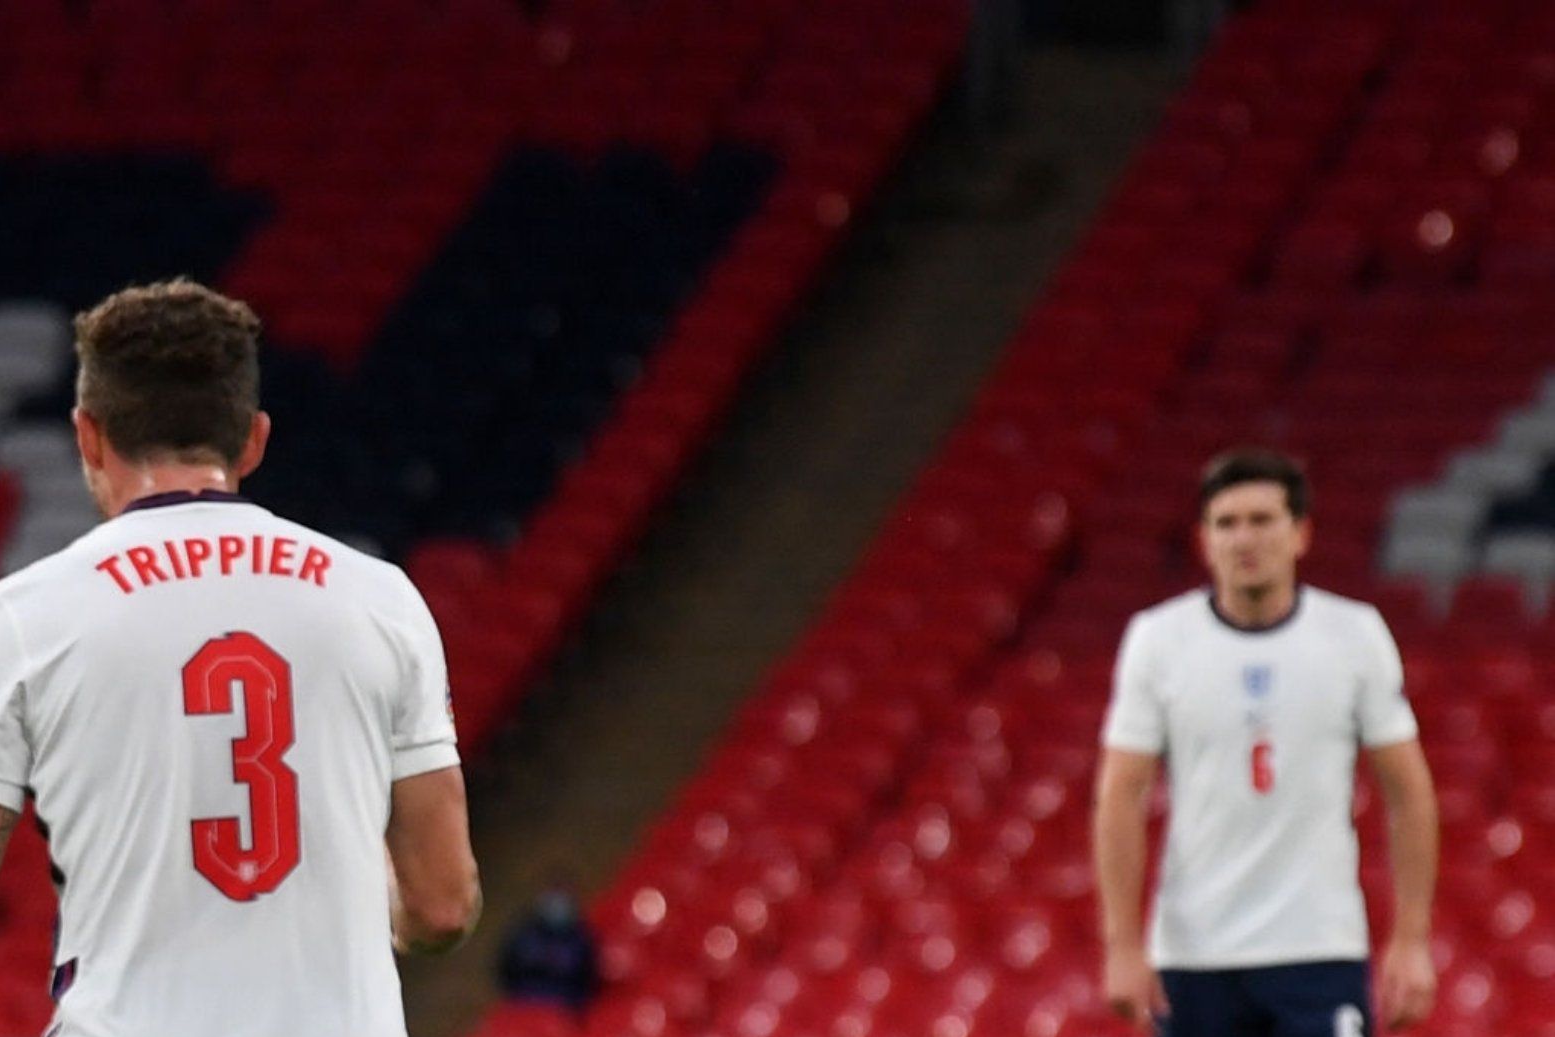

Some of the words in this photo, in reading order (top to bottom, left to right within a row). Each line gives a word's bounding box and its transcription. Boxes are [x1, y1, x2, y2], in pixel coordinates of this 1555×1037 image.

[95, 535, 332, 594] TRIPPIER
[182, 631, 301, 902] 3
[1250, 741, 1275, 796] 6
